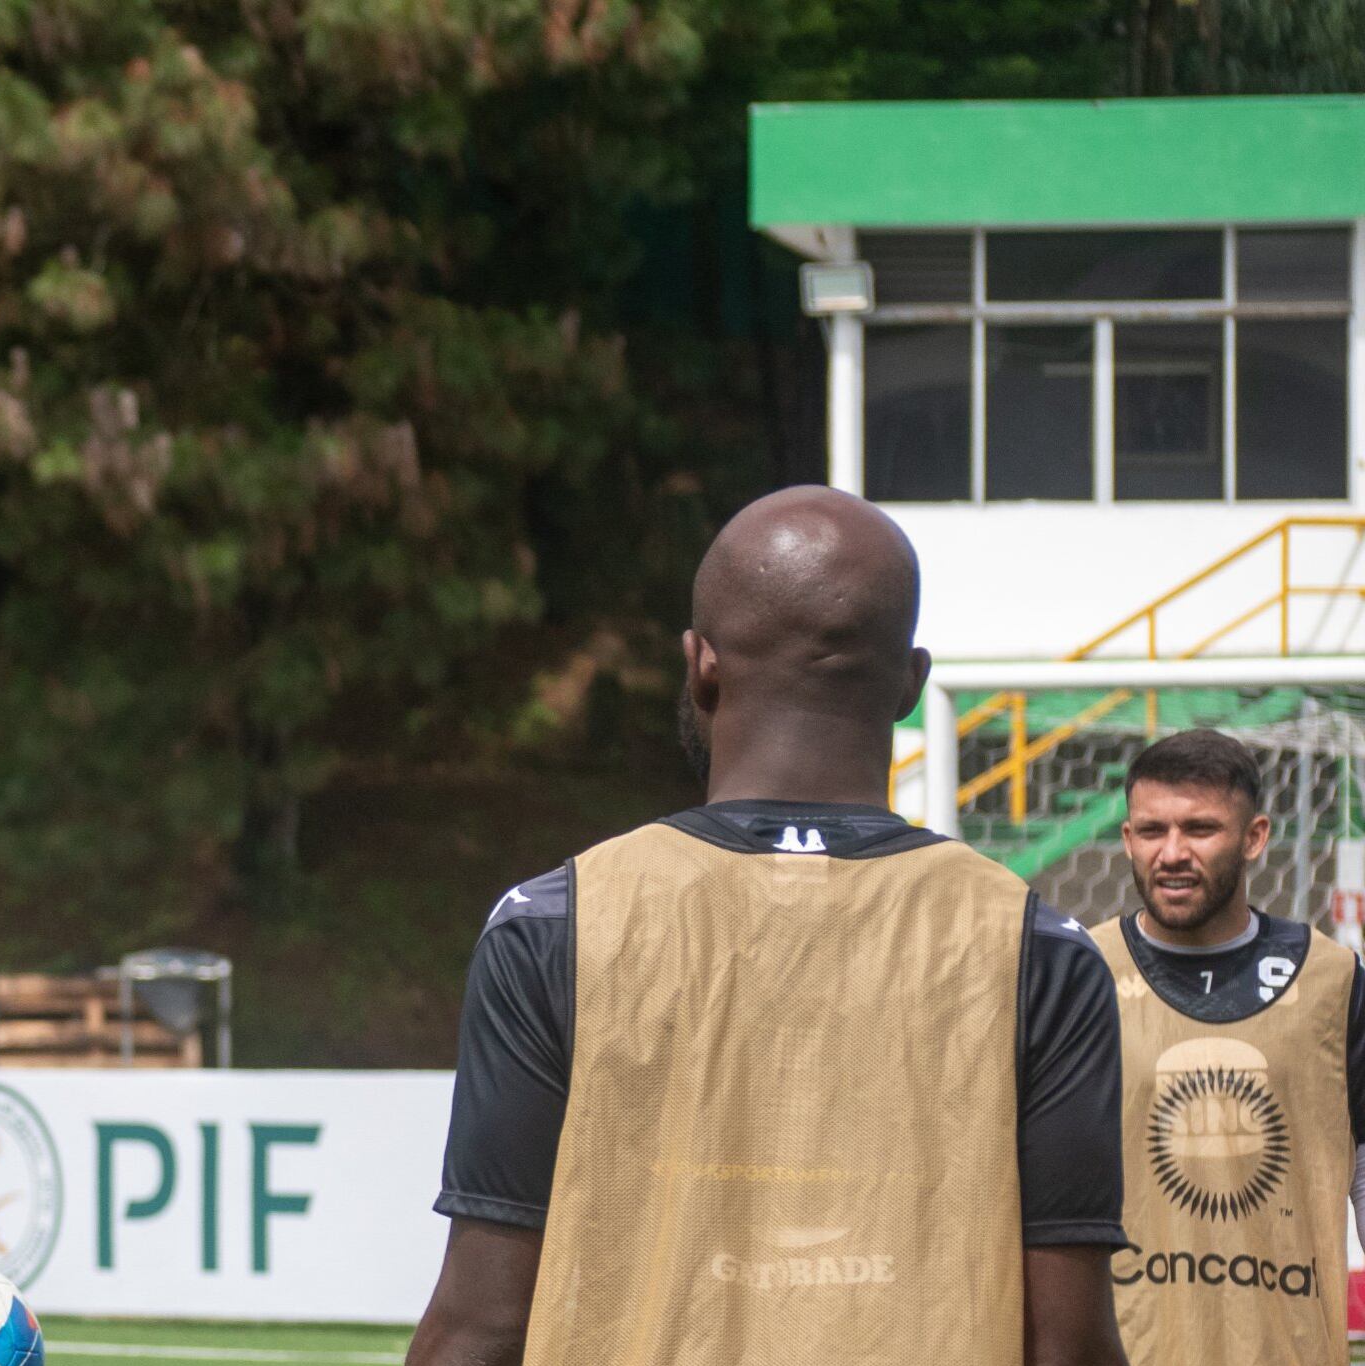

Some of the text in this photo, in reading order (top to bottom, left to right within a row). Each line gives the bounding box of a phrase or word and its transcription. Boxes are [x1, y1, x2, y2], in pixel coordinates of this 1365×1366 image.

[1200, 971, 1213, 994] 7
[93, 1120, 323, 1272] PIF
[1111, 1241, 1319, 1298] Concaca
